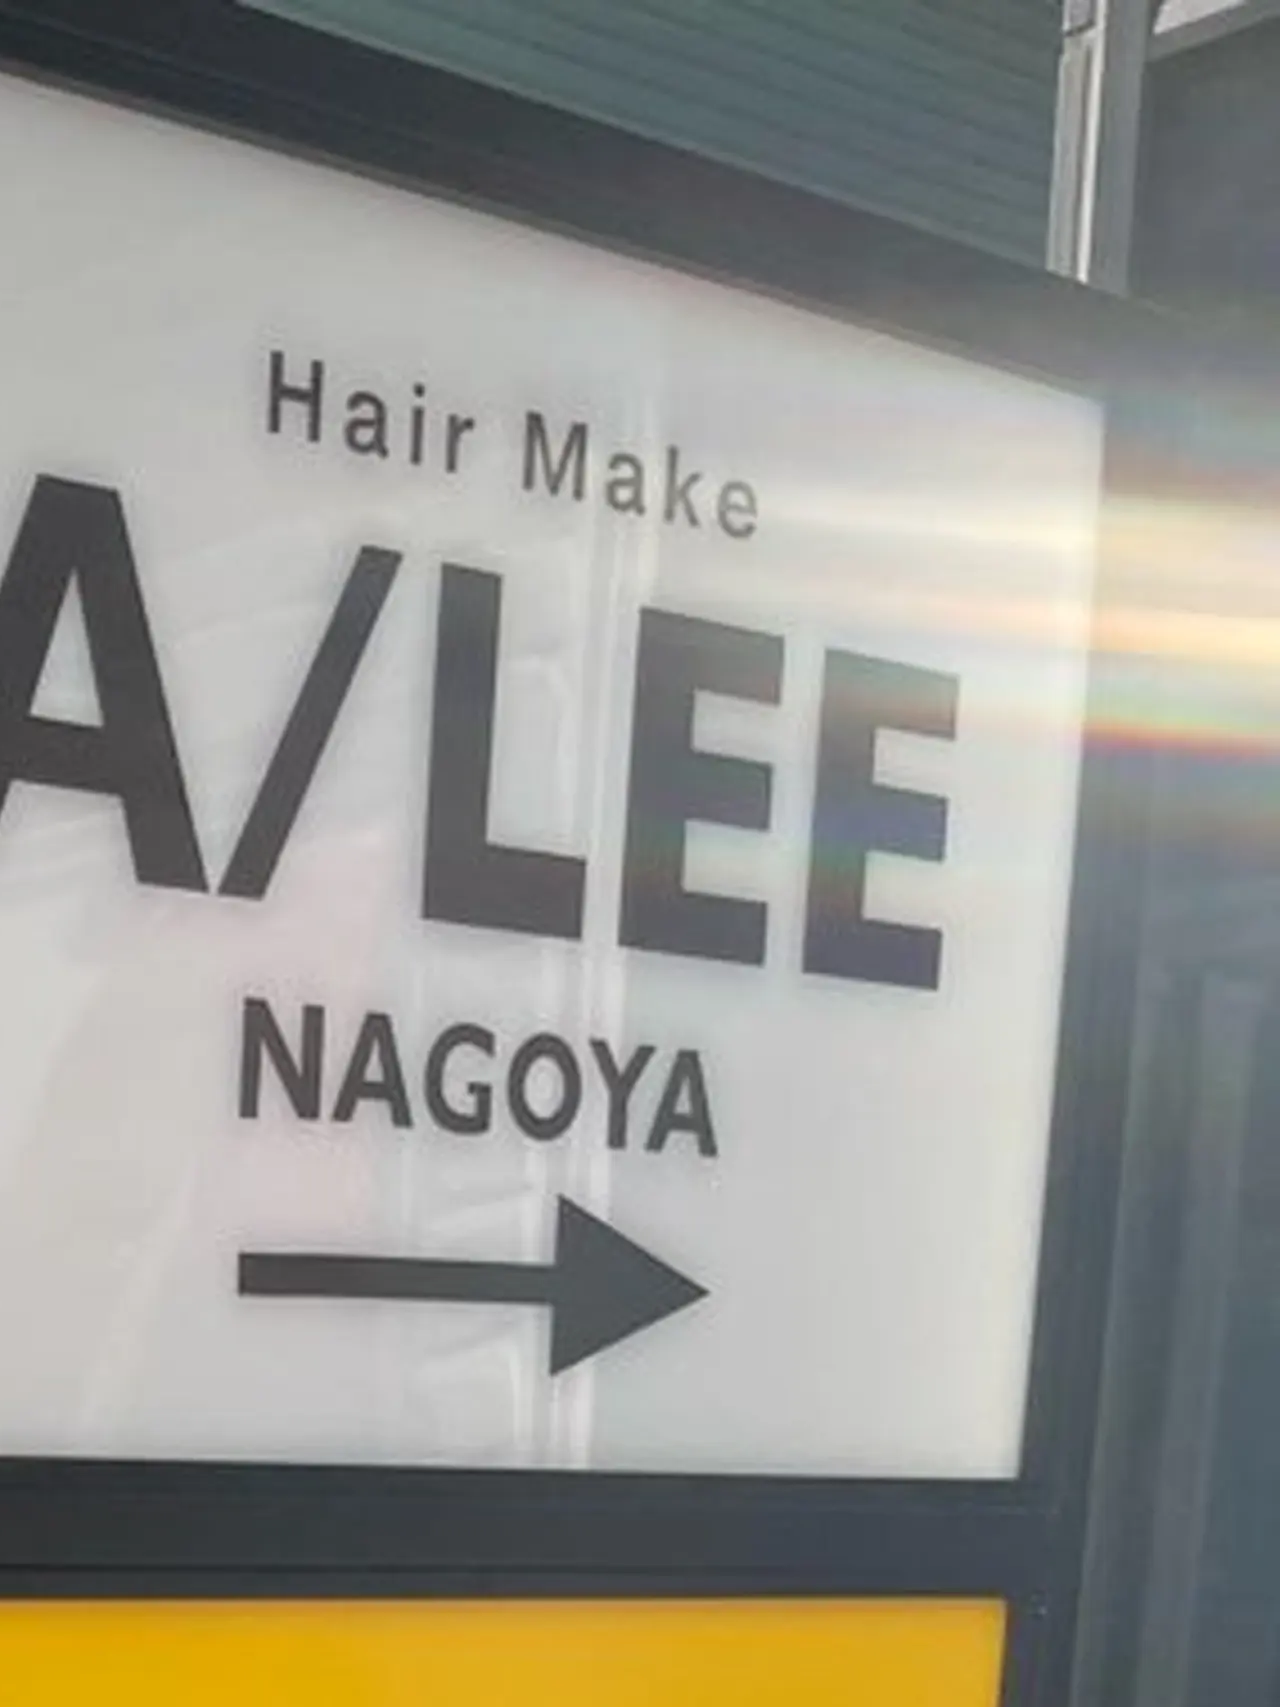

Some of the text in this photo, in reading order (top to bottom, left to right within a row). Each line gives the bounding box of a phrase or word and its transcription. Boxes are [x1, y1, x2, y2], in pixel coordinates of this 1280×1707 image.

[265, 348, 761, 545] Hair Make
[236, 993, 721, 1161] NAGOYA
